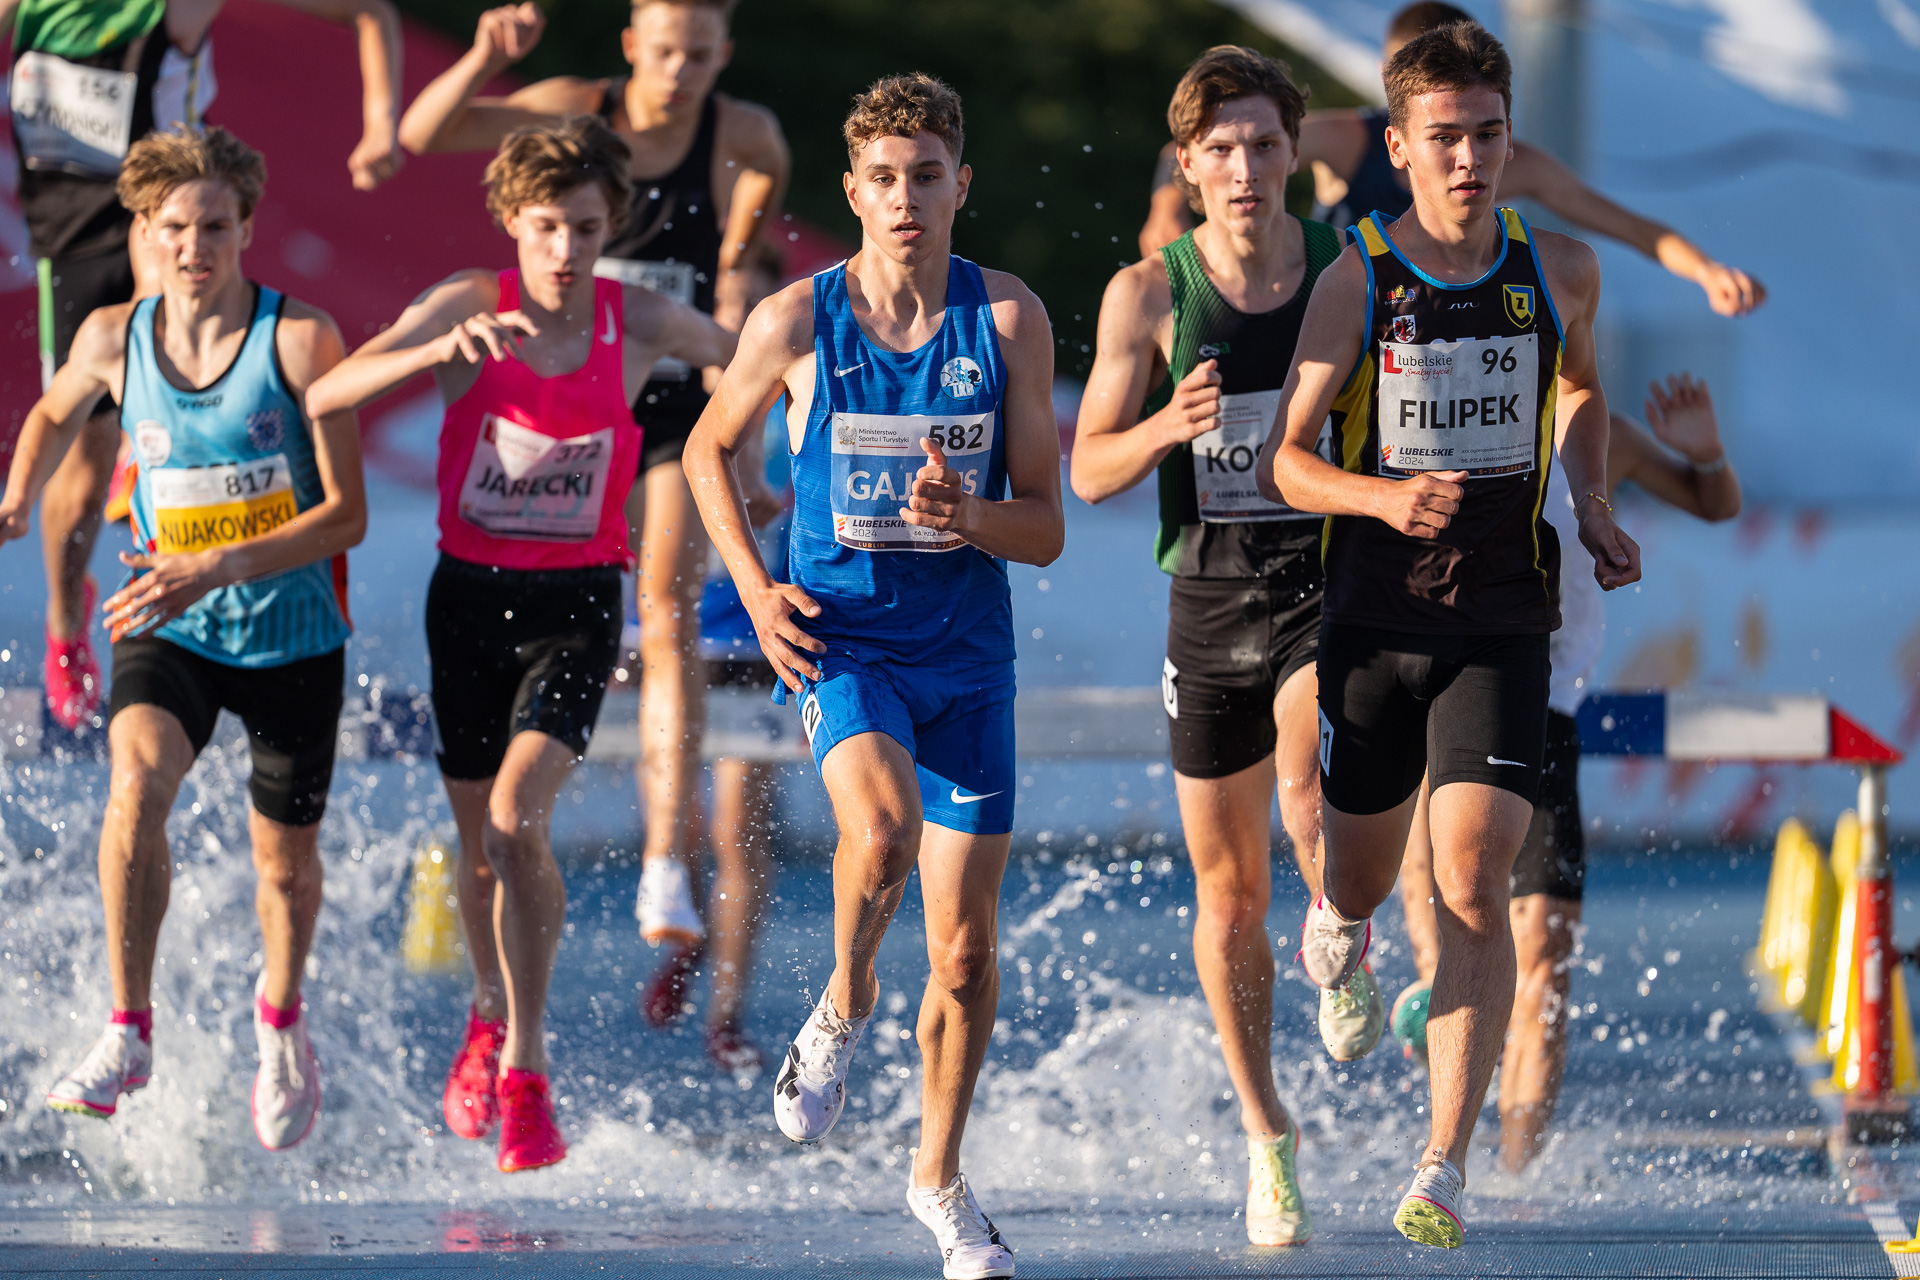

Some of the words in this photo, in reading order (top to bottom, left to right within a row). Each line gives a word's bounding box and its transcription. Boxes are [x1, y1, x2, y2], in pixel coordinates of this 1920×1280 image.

[1515, 297, 1525, 309] Z
[1481, 346, 1517, 374] 96
[1399, 393, 1520, 429] FILIPEK
[928, 423, 983, 450] 582
[1398, 456, 1424, 465] 2024
[1399, 447, 1454, 456] LUBELSKIE
[225, 466, 275, 497] 817
[475, 466, 593, 498] JARECKI
[852, 519, 907, 528] LUBELSKIE
[852, 528, 878, 537] 2024
[805, 700, 820, 734] 2
